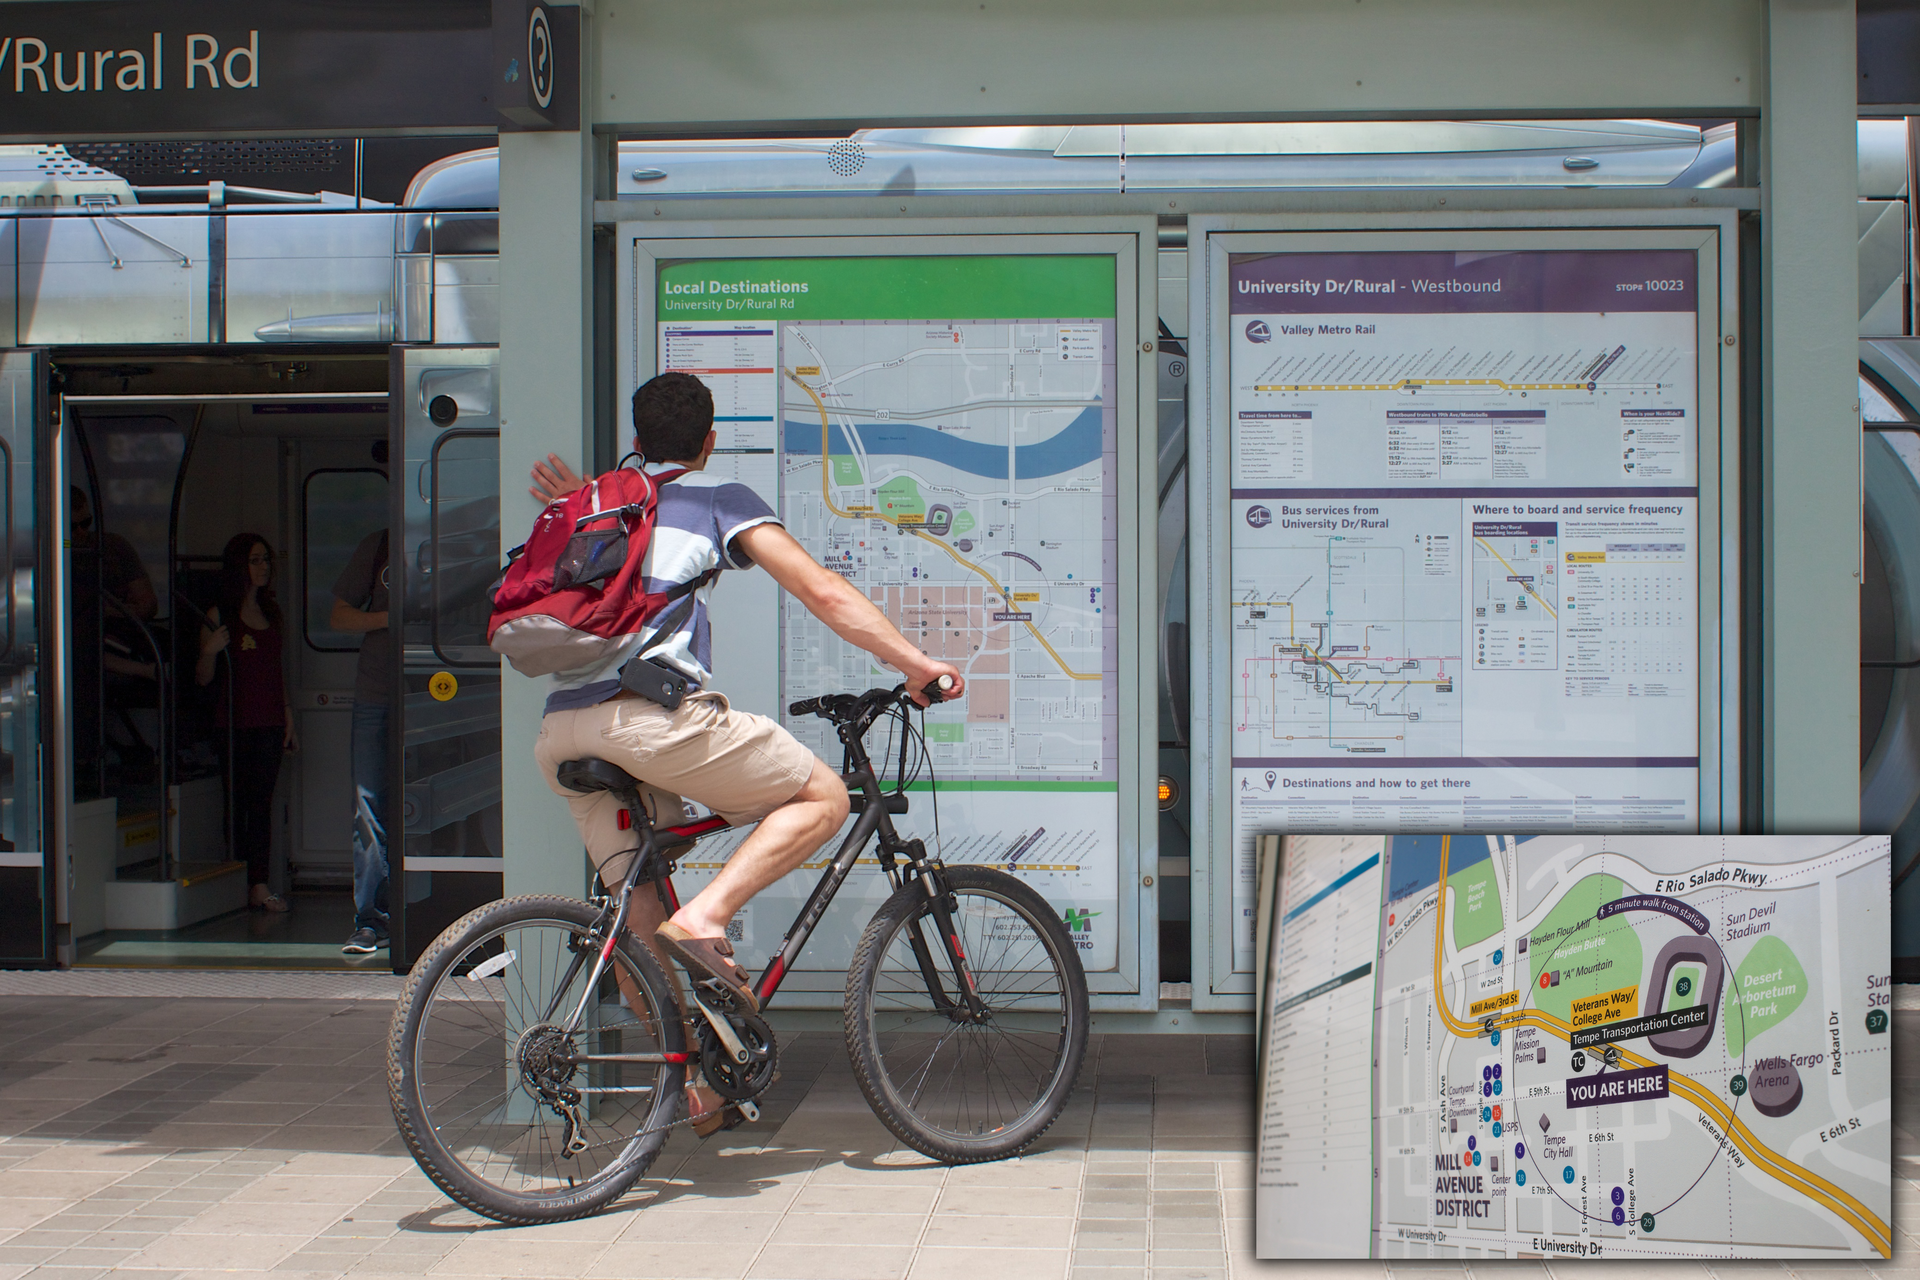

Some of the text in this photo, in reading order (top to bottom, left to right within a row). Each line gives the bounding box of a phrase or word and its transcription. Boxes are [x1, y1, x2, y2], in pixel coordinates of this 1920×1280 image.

[186, 29, 261, 90] Rd
[664, 279, 809, 295] Local Destinations
[1238, 279, 1321, 296] University
[1325, 277, 1396, 295] Dr/Rural
[1411, 277, 1501, 294] Westbound
[1615, 279, 1684, 292] STOP# 10023
[664, 297, 795, 312] University Dr/Rural Rd
[1280, 323, 1376, 337] Valley Metro Rail
[876, 410, 889, 419] 202
[1281, 505, 1379, 516] Bus services from
[1473, 503, 1684, 516] Where to board and service frequency
[1282, 517, 1390, 531] University Dr/Rural
[1474, 524, 1500, 532] University
[824, 555, 842, 563] MILL
[994, 613, 1031, 621] YOU ARE HERE
[1282, 777, 1471, 791] Destinations and how to get there
[1467, 879, 1487, 895] Tempe
[1655, 866, 1768, 894] E Rio Salado Pkwy
[798, 861, 848, 933] TREK
[1467, 890, 1485, 904] Beach
[1468, 901, 1483, 913] Park
[1608, 898, 1705, 931] 5 minute walk from station
[1725, 901, 1777, 927] Sun Devil
[1529, 918, 1591, 948] Hayden Flour Mill
[1726, 919, 1771, 942] Stadium
[1553, 936, 1607, 960] Hayden Butte
[1575, 958, 1614, 978] Mountain
[1743, 968, 1783, 988] Desert
[1678, 981, 1689, 992] 38
[1732, 983, 1797, 1006] Arboretum
[1470, 993, 1518, 1015] Mill Ave/3rd St
[1573, 988, 1637, 1014] Veterans Way/
[1572, 1006, 1622, 1028] College Ave
[1750, 1002, 1778, 1019] Park
[1573, 1009, 1706, 1045] Tempe Transportation Center
[1869, 1015, 1884, 1028] 37
[1515, 1027, 1537, 1040] Tempe
[1514, 1038, 1540, 1052] Mission
[1829, 1010, 1842, 1076] Packard Dr
[1514, 1051, 1535, 1064] Palms
[1573, 1056, 1584, 1068] TC
[1754, 1052, 1824, 1072] Wells Fargo
[1570, 1074, 1664, 1102] YOU ARE HERE
[1733, 1080, 1744, 1091] 39
[1754, 1074, 1790, 1089] Arena
[1502, 1121, 1519, 1133] USPS
[1819, 1117, 1862, 1143] E 6th St
[1543, 1134, 1566, 1147] Tempe
[1588, 1132, 1615, 1143] E 6th St
[1697, 1112, 1746, 1169] Veterans Way
[1543, 1145, 1574, 1161] City Hall
[1435, 1153, 1462, 1172] MILL
[1435, 1175, 1484, 1194] AVENUE
[1531, 1186, 1554, 1196] E 7th St
[1435, 1199, 1491, 1219] DISTRICT
[1628, 1189, 1637, 1227] College
[1643, 1217, 1653, 1227] 29
[1533, 1238, 1603, 1257] E University Dr
